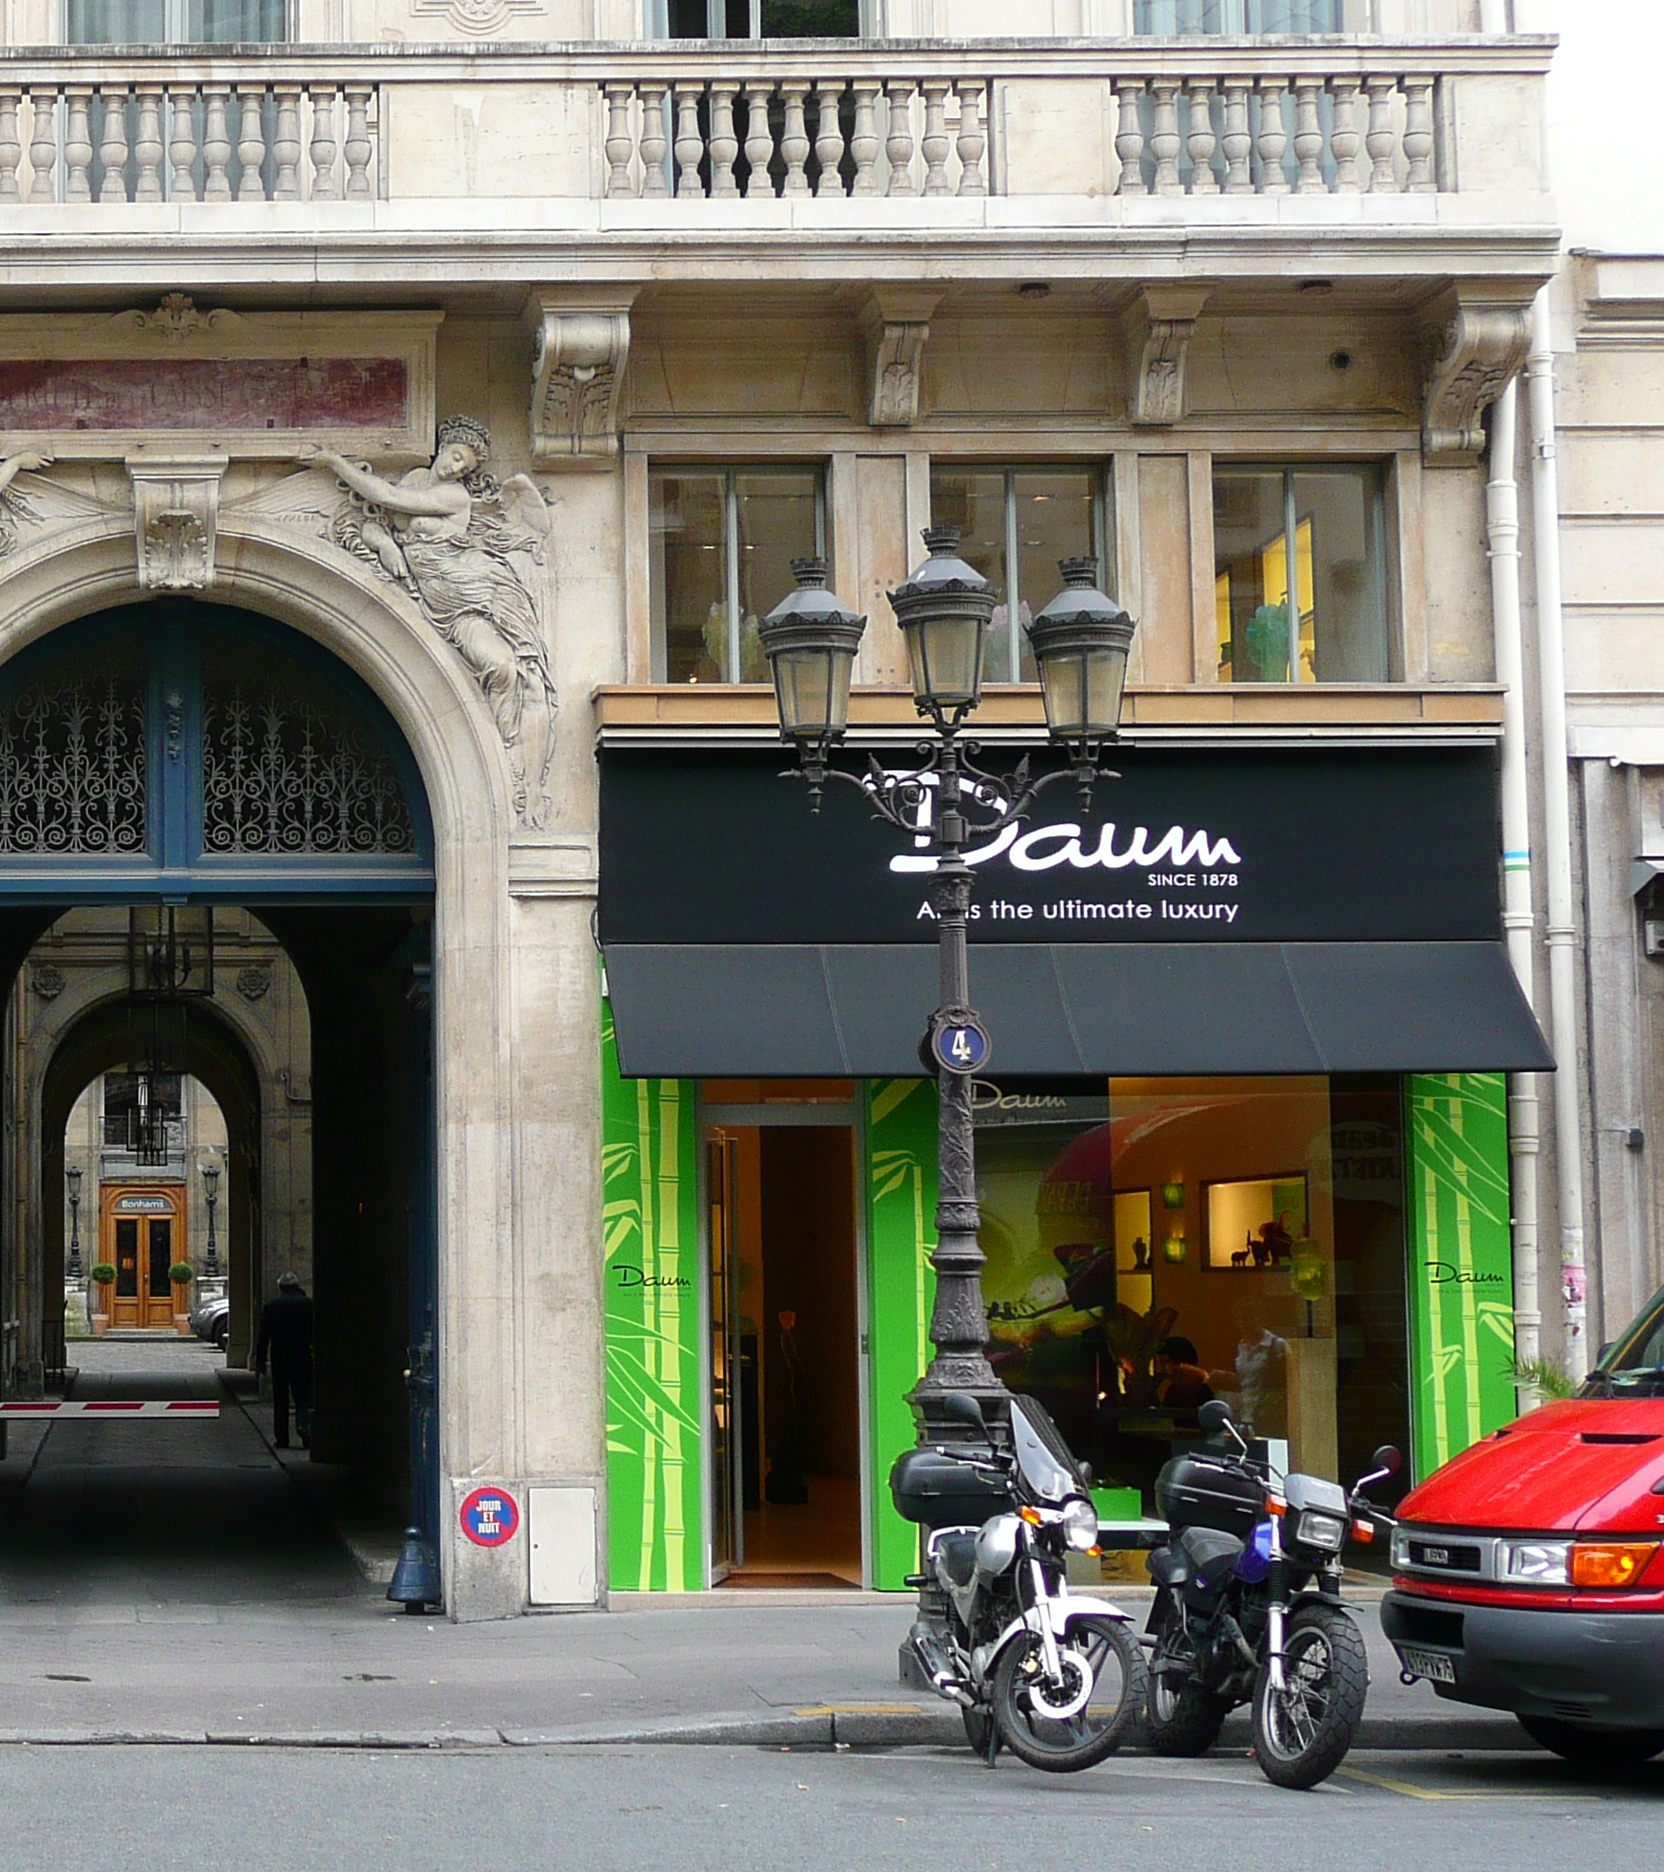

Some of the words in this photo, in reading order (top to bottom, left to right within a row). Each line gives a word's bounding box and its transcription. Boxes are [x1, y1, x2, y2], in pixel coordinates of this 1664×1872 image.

[861, 769, 1242, 872] Daum
[1147, 873, 1196, 887] SINCE
[1201, 873, 1239, 887] 1878
[990, 899, 1034, 920] the
[1042, 899, 1153, 920] ultimate
[1161, 899, 1239, 923] luxury
[951, 1029, 972, 1061] 4
[969, 1078, 1067, 1110] Daum
[121, 1199, 165, 1209] Bonhams
[612, 1265, 692, 1287] Daum
[1423, 1261, 1505, 1284] Daum
[475, 1500, 502, 1511] JOUR
[483, 1511, 495, 1522] ET
[478, 1522, 501, 1534] NUIT
